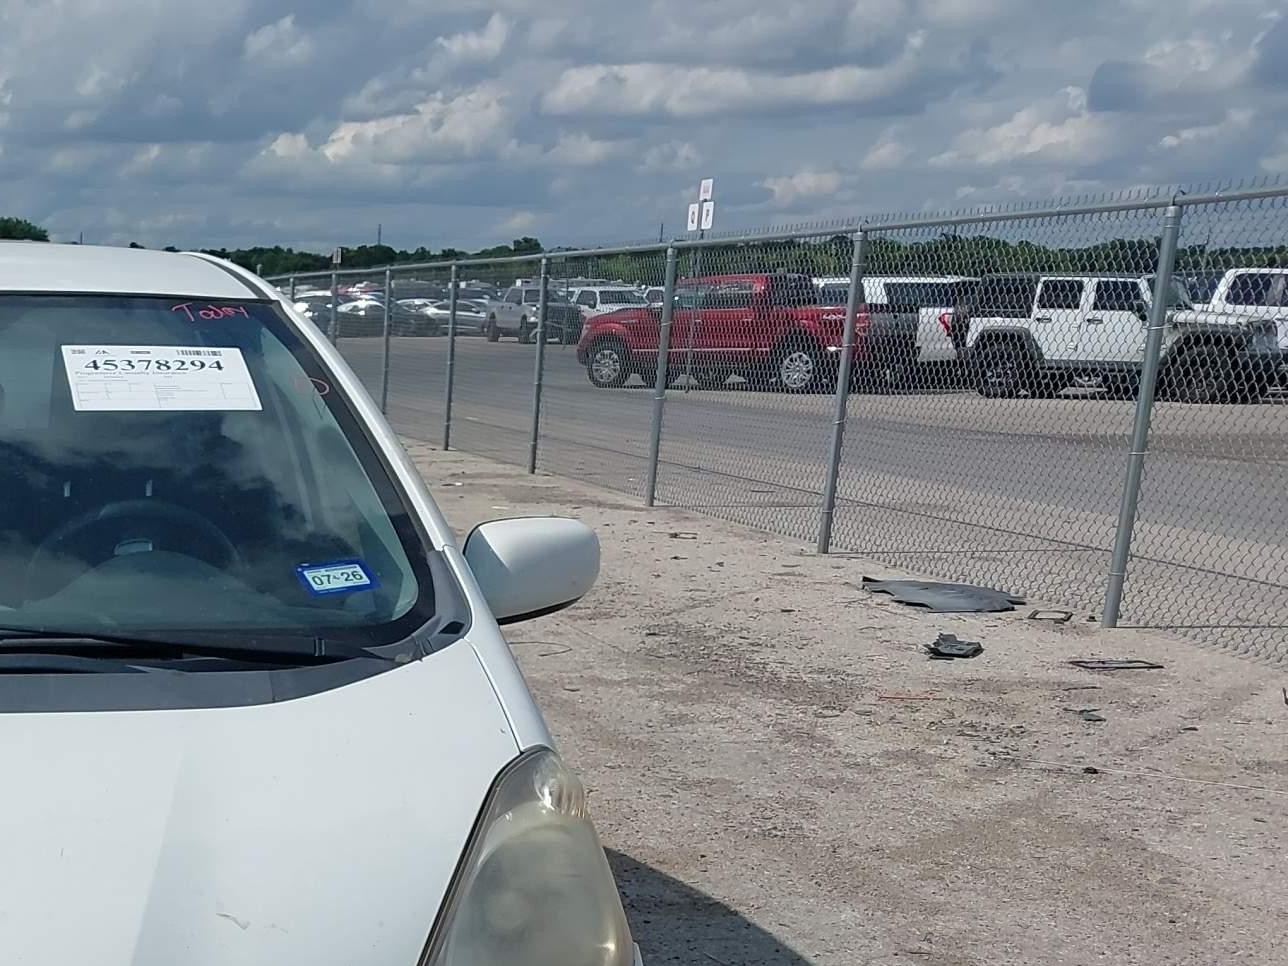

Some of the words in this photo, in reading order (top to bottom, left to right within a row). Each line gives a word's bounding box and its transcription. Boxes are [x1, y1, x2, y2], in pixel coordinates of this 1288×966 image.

[84, 359, 224, 371] 45378294
[311, 574, 332, 586] 07
[341, 570, 364, 582] 26
